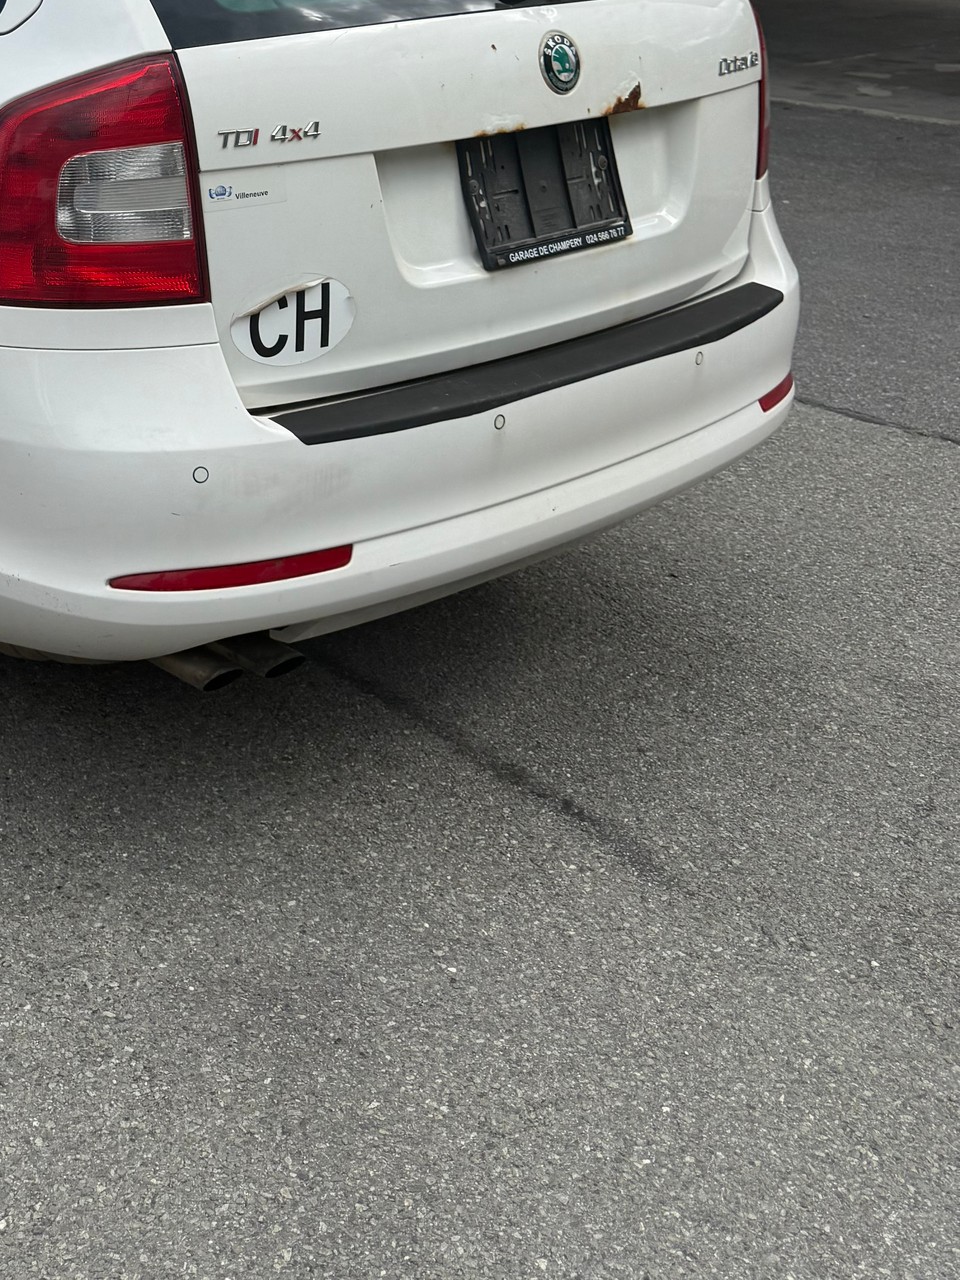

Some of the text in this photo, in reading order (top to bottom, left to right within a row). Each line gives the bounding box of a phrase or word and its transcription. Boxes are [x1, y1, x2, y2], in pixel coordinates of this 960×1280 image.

[218, 121, 321, 149] TDI 4x4
[235, 190, 269, 200] Villeneuve
[509, 248, 539, 263] GARAGE
[539, 246, 549, 256] DE
[548, 237, 582, 254] CHAMPERY
[585, 234, 598, 244] 024
[617, 227, 625, 236] 77
[249, 282, 330, 358] CH
